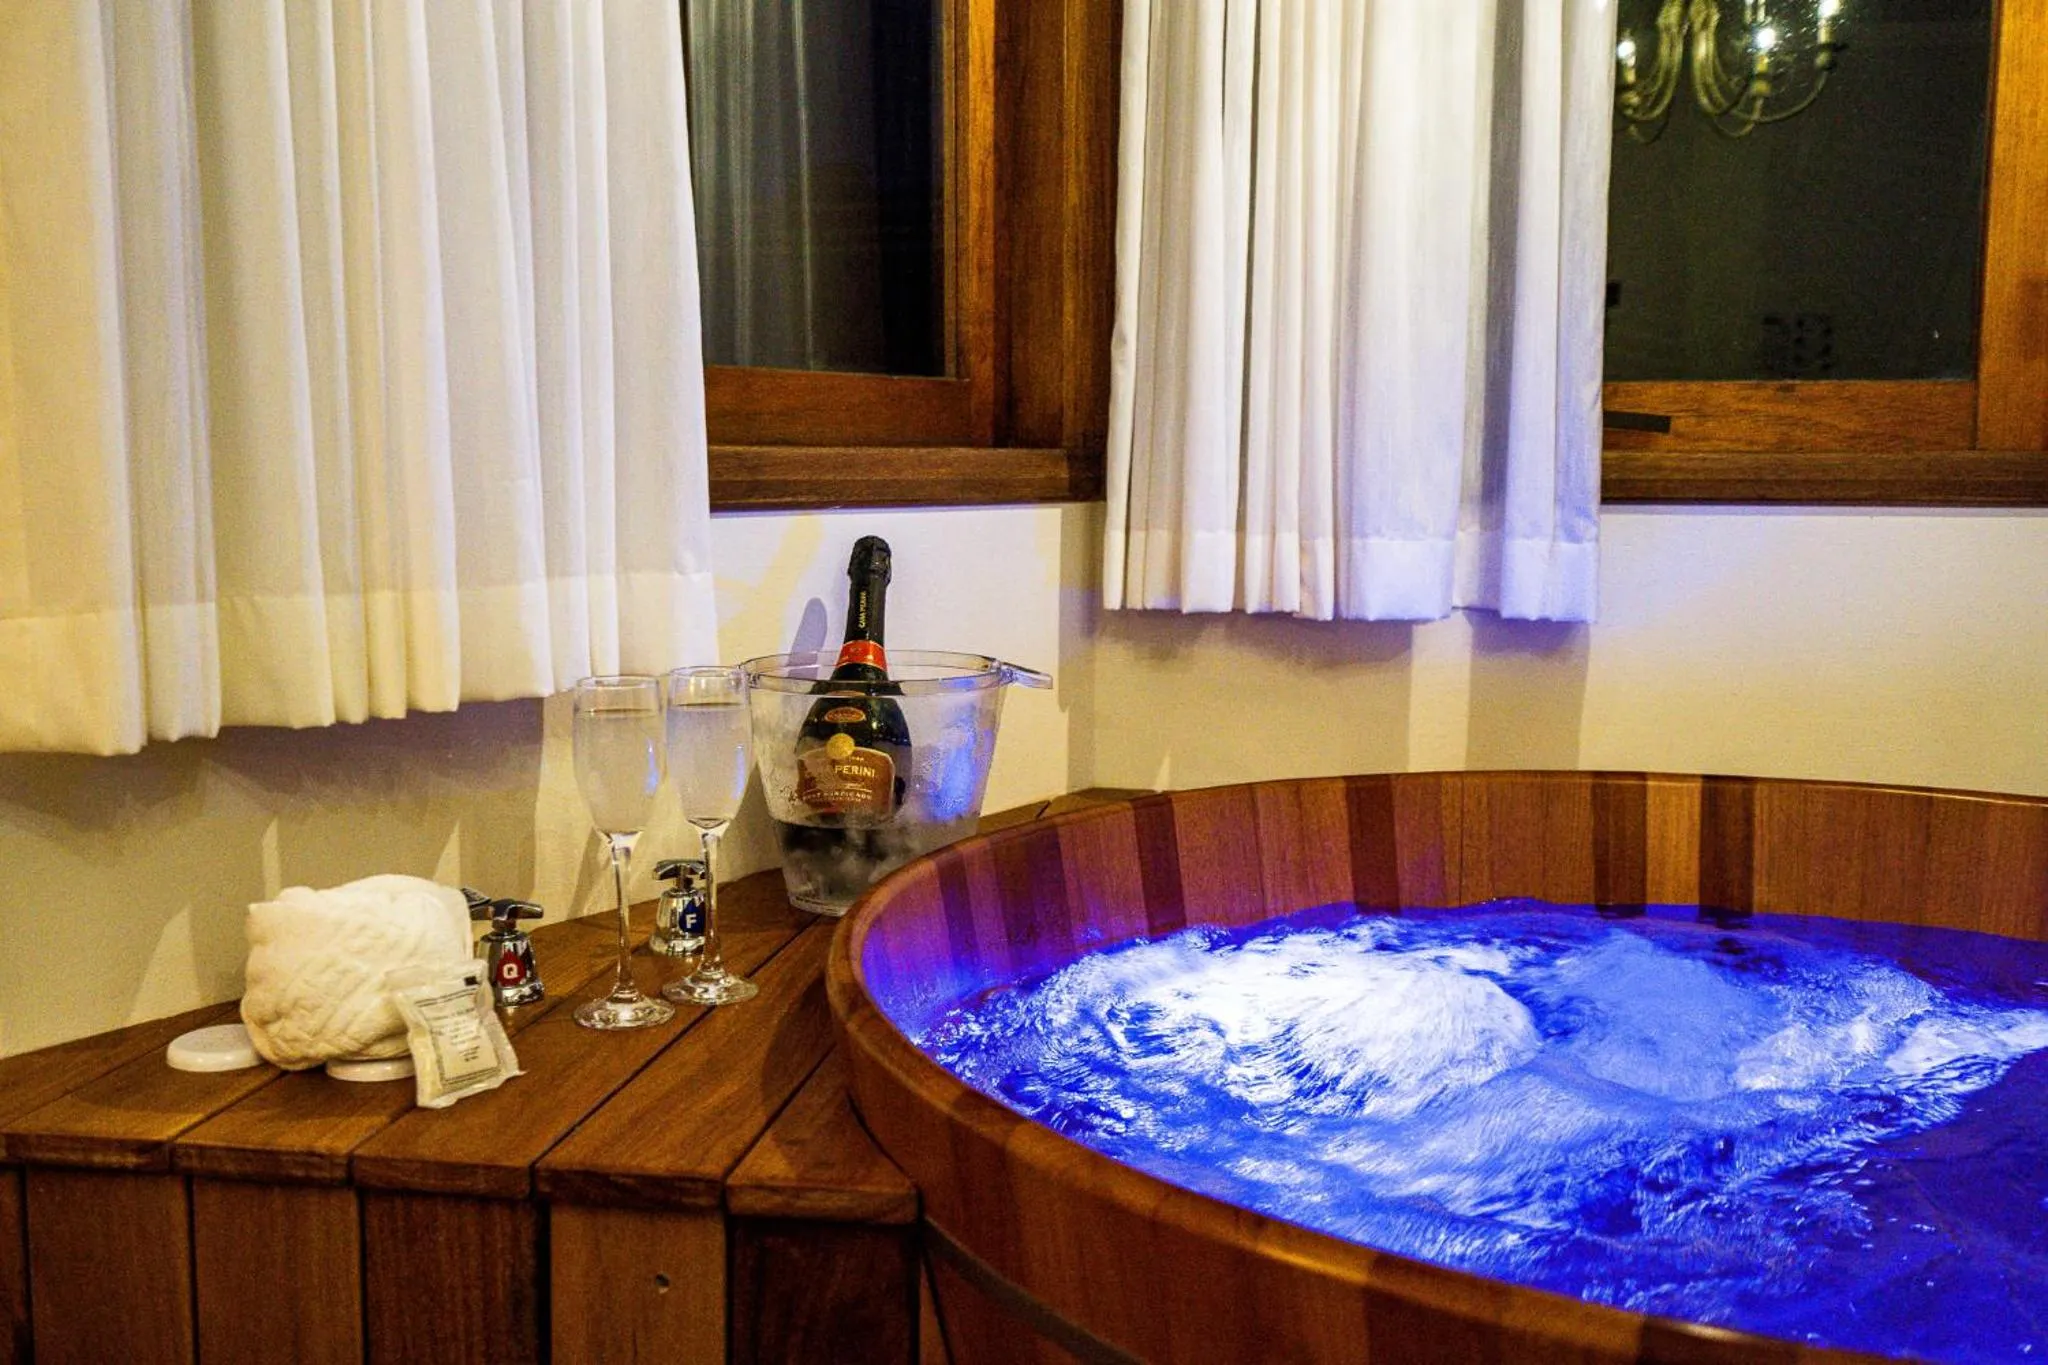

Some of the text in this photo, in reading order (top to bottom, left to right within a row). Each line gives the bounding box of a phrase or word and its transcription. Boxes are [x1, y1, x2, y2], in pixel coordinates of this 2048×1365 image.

[834, 764, 876, 778] PERINI
[685, 913, 697, 929] F
[502, 963, 520, 980] Q
